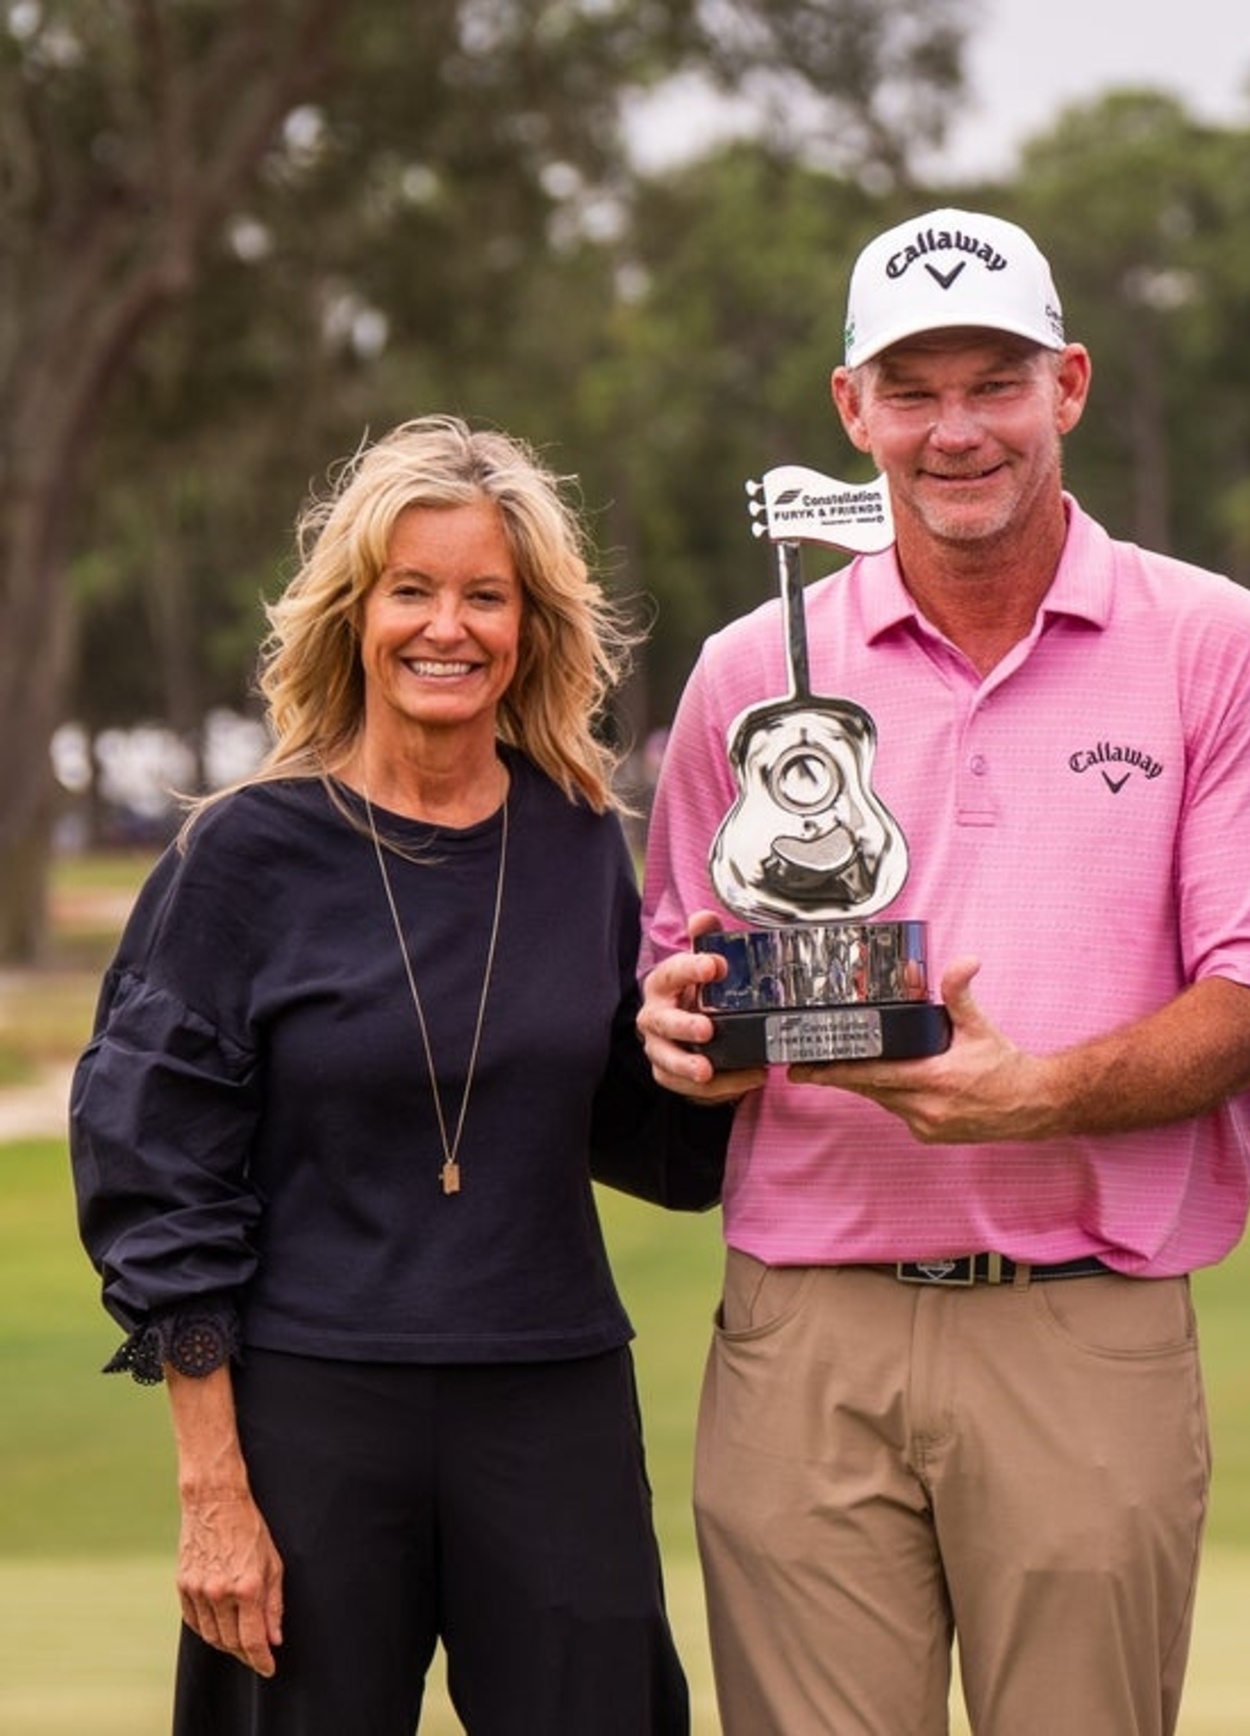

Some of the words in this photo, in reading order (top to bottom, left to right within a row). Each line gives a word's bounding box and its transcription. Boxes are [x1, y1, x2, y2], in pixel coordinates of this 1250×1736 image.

[885, 228, 1008, 280] Callaway
[774, 508, 814, 521] FURYK
[818, 508, 826, 516] &
[830, 504, 882, 516] FRIENDS
[802, 491, 882, 507] Constellation
[1069, 741, 1164, 780] Callaway
